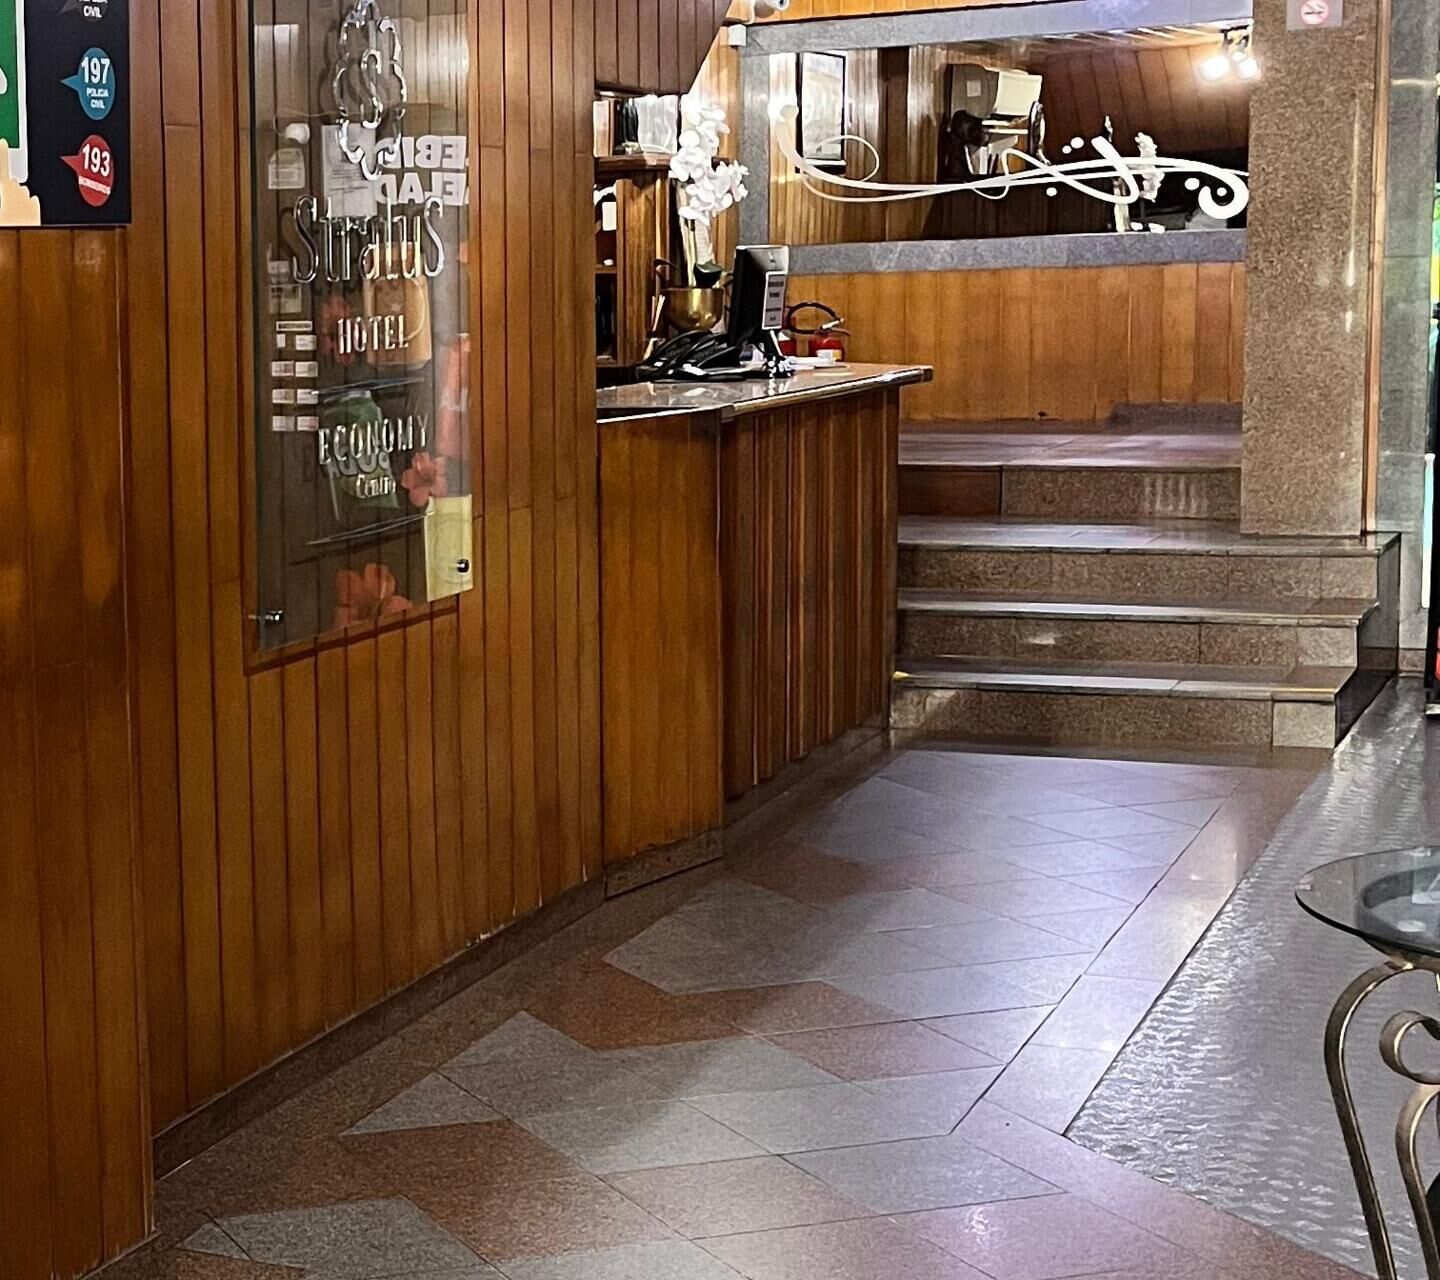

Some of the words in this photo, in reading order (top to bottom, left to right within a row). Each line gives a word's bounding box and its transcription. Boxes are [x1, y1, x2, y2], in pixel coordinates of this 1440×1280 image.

[81, 56, 110, 84] 197
[82, 143, 110, 177] 193
[337, 314, 409, 354] HOTEL
[318, 414, 428, 465] ECONOMY
